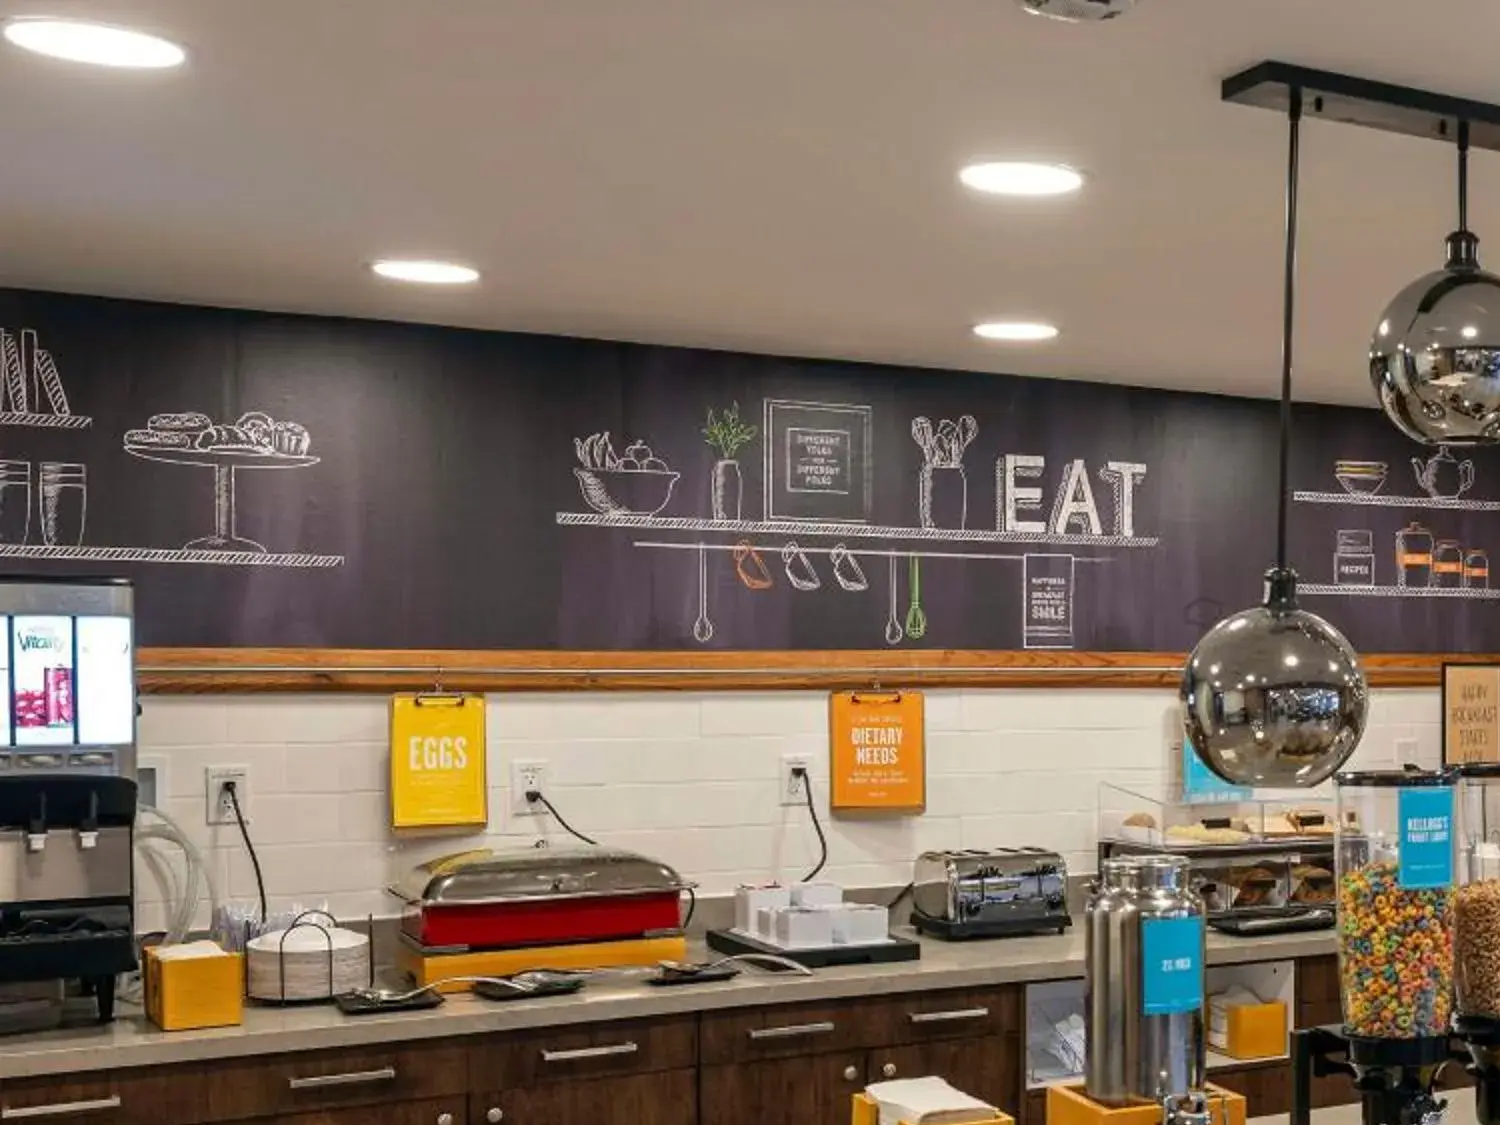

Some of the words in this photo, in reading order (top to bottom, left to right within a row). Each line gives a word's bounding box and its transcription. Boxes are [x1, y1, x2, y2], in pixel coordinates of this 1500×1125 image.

[996, 454, 1147, 537] EAT
[1031, 605, 1065, 619] SMILE
[851, 727, 903, 745] DIETARY
[410, 736, 467, 771] EGGS
[856, 746, 898, 765] NEEDS
